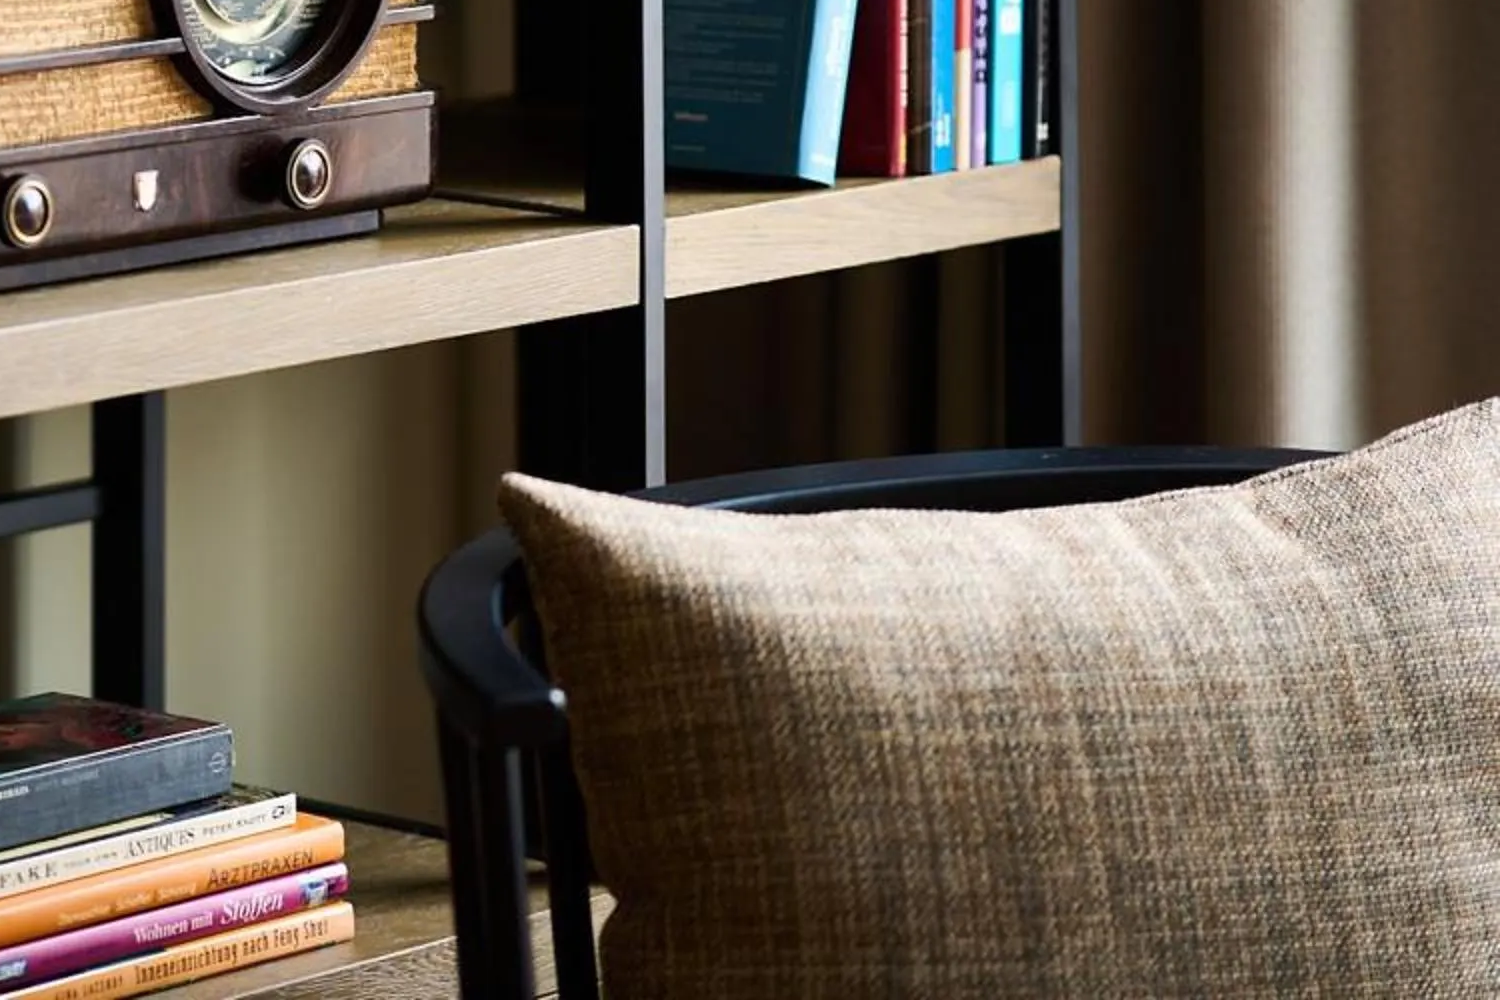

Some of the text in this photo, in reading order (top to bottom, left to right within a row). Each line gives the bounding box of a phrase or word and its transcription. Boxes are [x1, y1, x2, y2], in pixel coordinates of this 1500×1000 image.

[0, 863, 58, 889] FAKE
[124, 827, 196, 859] ANTIQUES
[207, 848, 314, 890] ARZTPRAXEN
[133, 918, 188, 944] Wohnen
[190, 911, 214, 932] mit
[219, 890, 284, 926] Stoffen
[243, 934, 270, 957] nach
[274, 925, 300, 950] Feng
[302, 917, 329, 941] Shui
